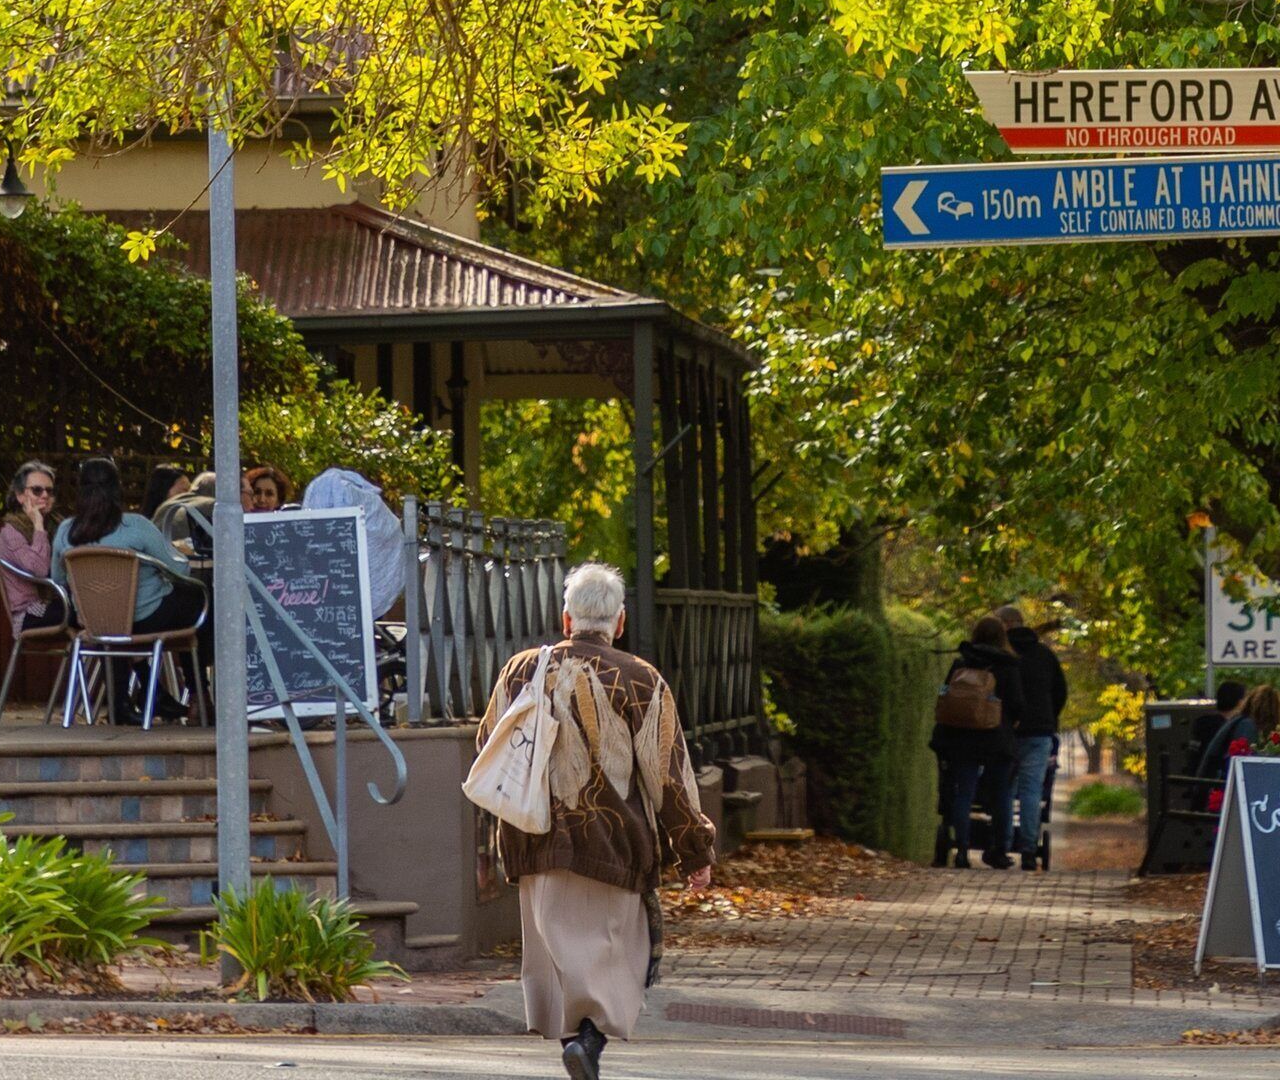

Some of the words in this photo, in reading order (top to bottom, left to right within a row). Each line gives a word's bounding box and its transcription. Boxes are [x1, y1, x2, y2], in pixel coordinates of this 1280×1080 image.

[1014, 78, 1234, 123] HEREFORD
[1065, 128, 1089, 147] NO
[1097, 127, 1181, 147] THROUGH
[1187, 126, 1236, 146] ROAD
[982, 188, 1041, 220] 150m
[1053, 168, 1137, 210] AMBLE
[1155, 166, 1183, 206] AT
[1059, 211, 1093, 234] SELF
[1100, 208, 1176, 231] CONTAINED
[1182, 206, 1211, 228] B&B
